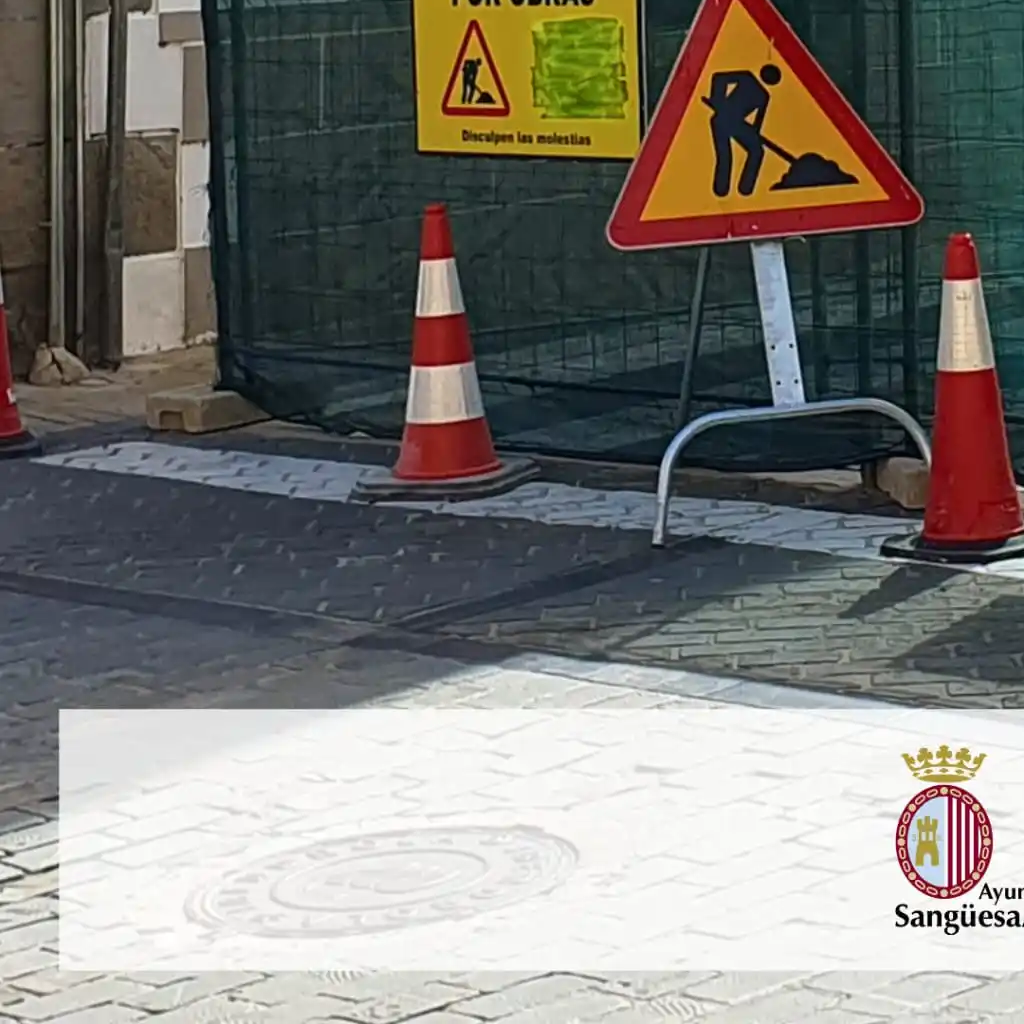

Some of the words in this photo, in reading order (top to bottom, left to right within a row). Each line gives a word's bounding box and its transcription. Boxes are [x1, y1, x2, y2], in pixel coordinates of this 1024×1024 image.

[462, 129, 514, 146] Disculpen
[517, 132, 533, 144] las
[536, 132, 591, 146] molestias
